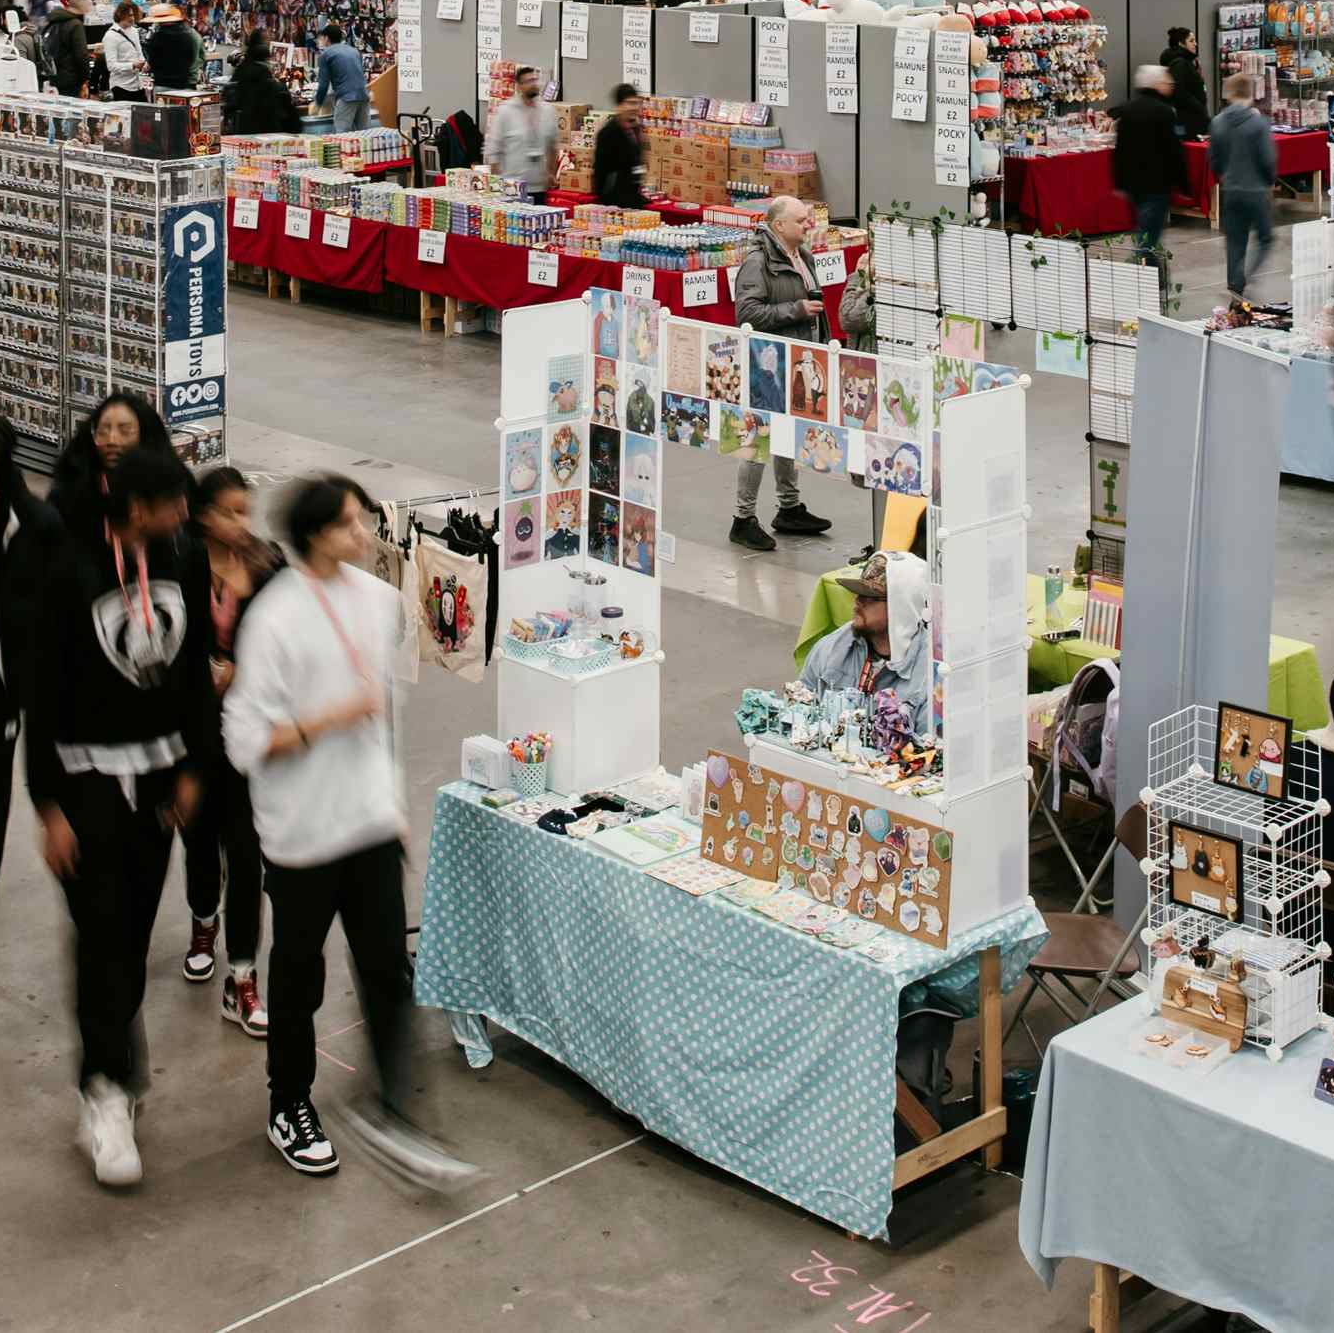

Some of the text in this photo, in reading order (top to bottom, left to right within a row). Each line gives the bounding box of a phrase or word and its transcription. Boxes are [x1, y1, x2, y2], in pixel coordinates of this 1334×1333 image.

[519, 2, 539, 11] POCKY
[571, 19, 579, 28] £2
[761, 21, 786, 32] POCKY
[405, 30, 413, 38] £2
[484, 37, 492, 45] £2
[625, 40, 647, 49] POCKY
[769, 35, 777, 44] £2
[907, 46, 916, 55] £2
[479, 52, 499, 60] POCKY
[632, 52, 640, 61] £2
[826, 56, 856, 66] RAMUNE
[895, 61, 926, 72] RAMUNE
[938, 66, 966, 76] SNACKS
[837, 69, 846, 79] £2
[759, 79, 788, 89] RAMUNE
[905, 76, 915, 86] £2
[947, 79, 956, 88] £2
[769, 92, 778, 101] £2
[829, 88, 854, 97] POCKY
[896, 93, 924, 104] POCKY
[936, 96, 968, 107] RAMUNE
[837, 101, 845, 110] £2
[903, 108, 913, 117] £2
[947, 110, 957, 120] £2
[938, 129, 967, 140] POCKY
[946, 143, 956, 153] £2
[947, 172, 957, 182] £2
[241, 214, 249, 225] £2
[330, 232, 339, 242] £2
[426, 248, 435, 258] £2
[815, 256, 843, 269] POCKY
[537, 271, 547, 281] £2
[625, 271, 652, 283] DRINKS
[684, 272, 717, 287] RAMUNE
[825, 272, 836, 283] £2
[633, 285, 643, 295] £2
[696, 290, 708, 301] £2
[188, 267, 204, 378] PERSONA TOYS
